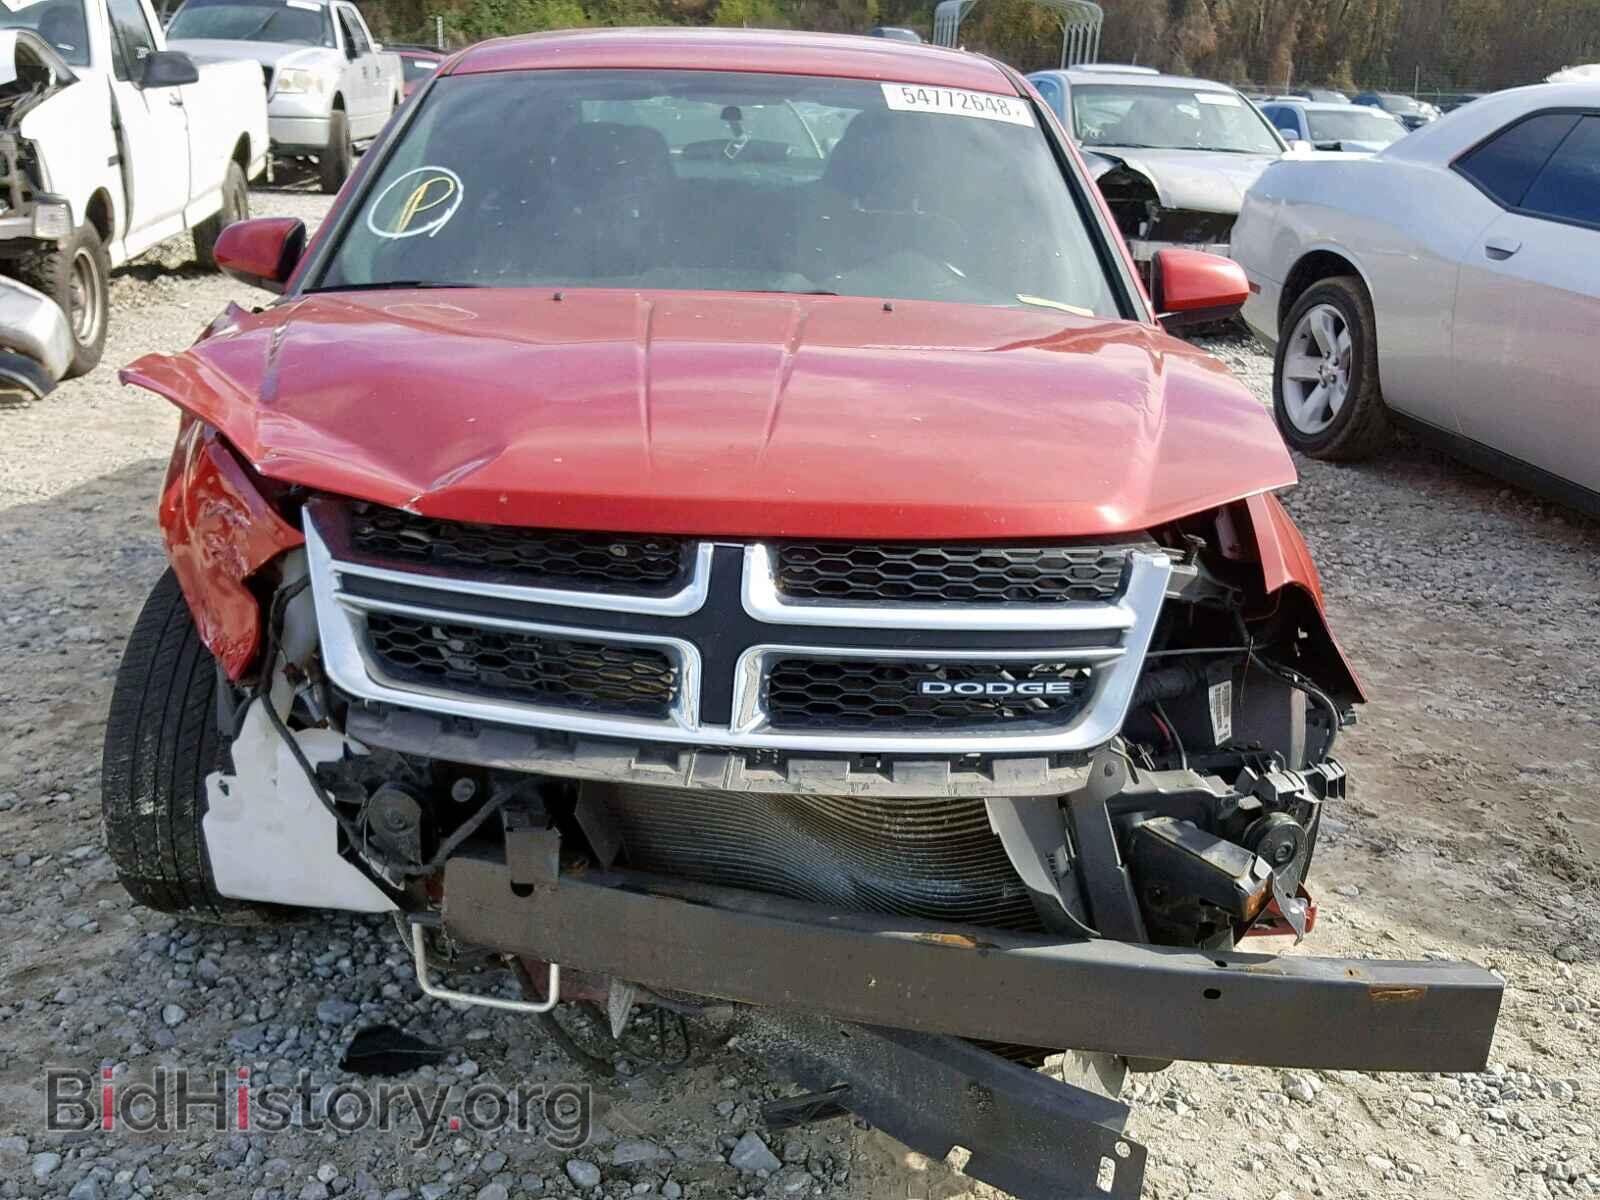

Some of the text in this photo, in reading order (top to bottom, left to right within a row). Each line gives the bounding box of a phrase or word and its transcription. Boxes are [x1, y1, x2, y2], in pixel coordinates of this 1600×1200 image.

[901, 87, 1012, 116] 54772648
[396, 176, 455, 234] P
[921, 682, 1071, 695] DODGE
